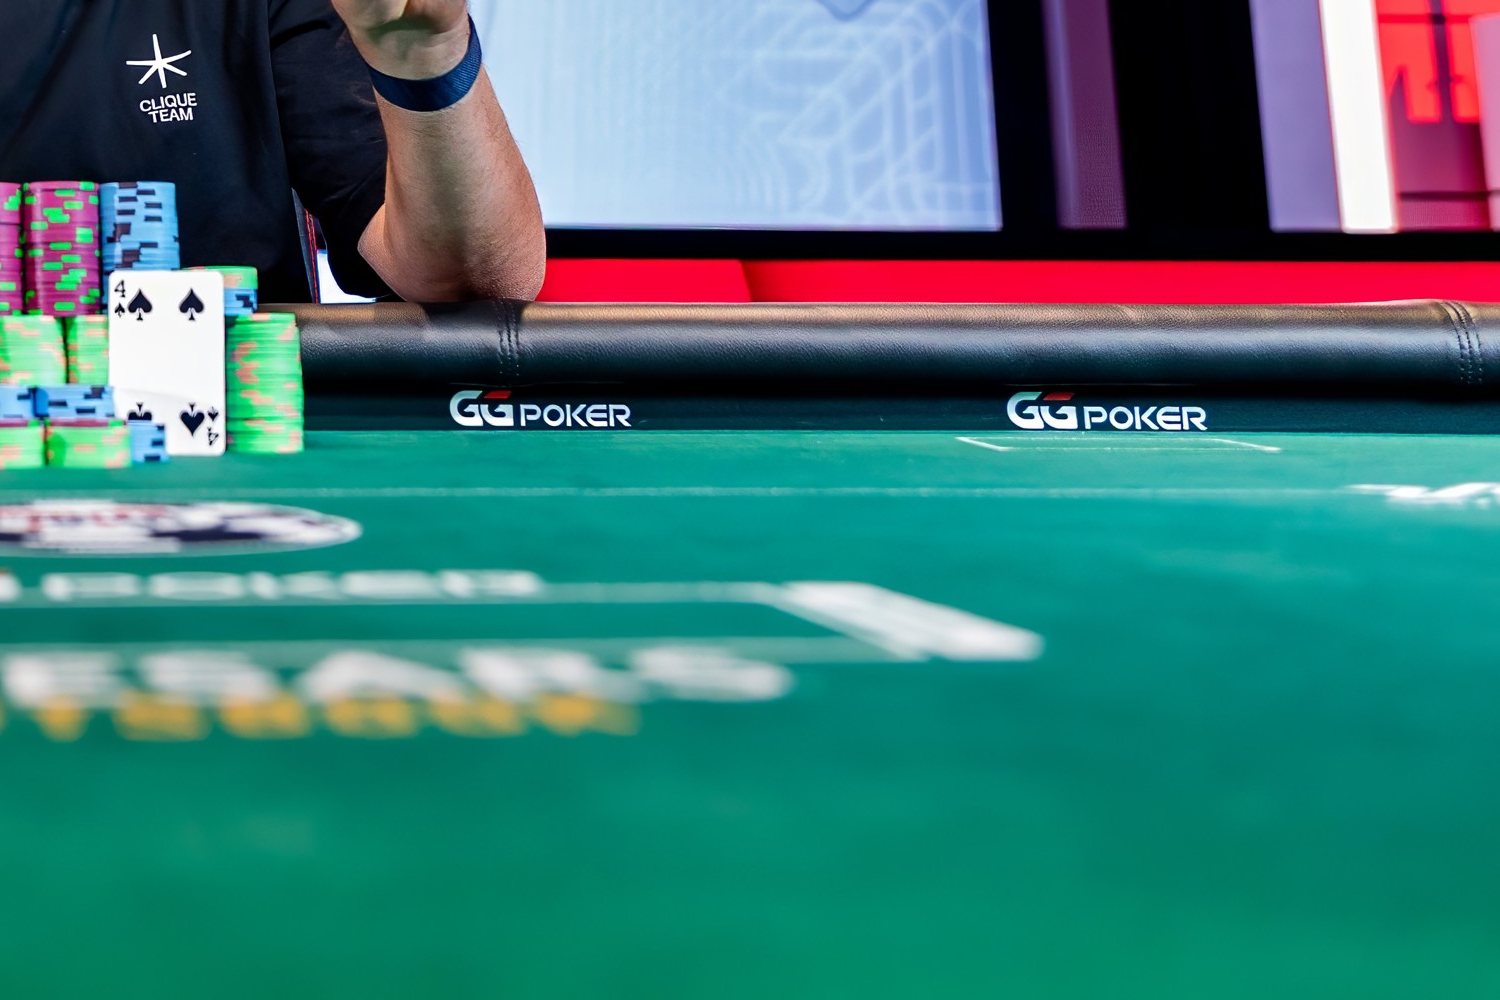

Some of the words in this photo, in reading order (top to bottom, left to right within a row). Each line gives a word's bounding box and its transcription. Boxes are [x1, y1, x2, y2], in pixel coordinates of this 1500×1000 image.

[139, 92, 198, 112] CLIQUE
[147, 107, 194, 123] TEAM
[114, 279, 127, 298] 4
[520, 404, 632, 427] POKER
[1083, 406, 1208, 431] POKER
